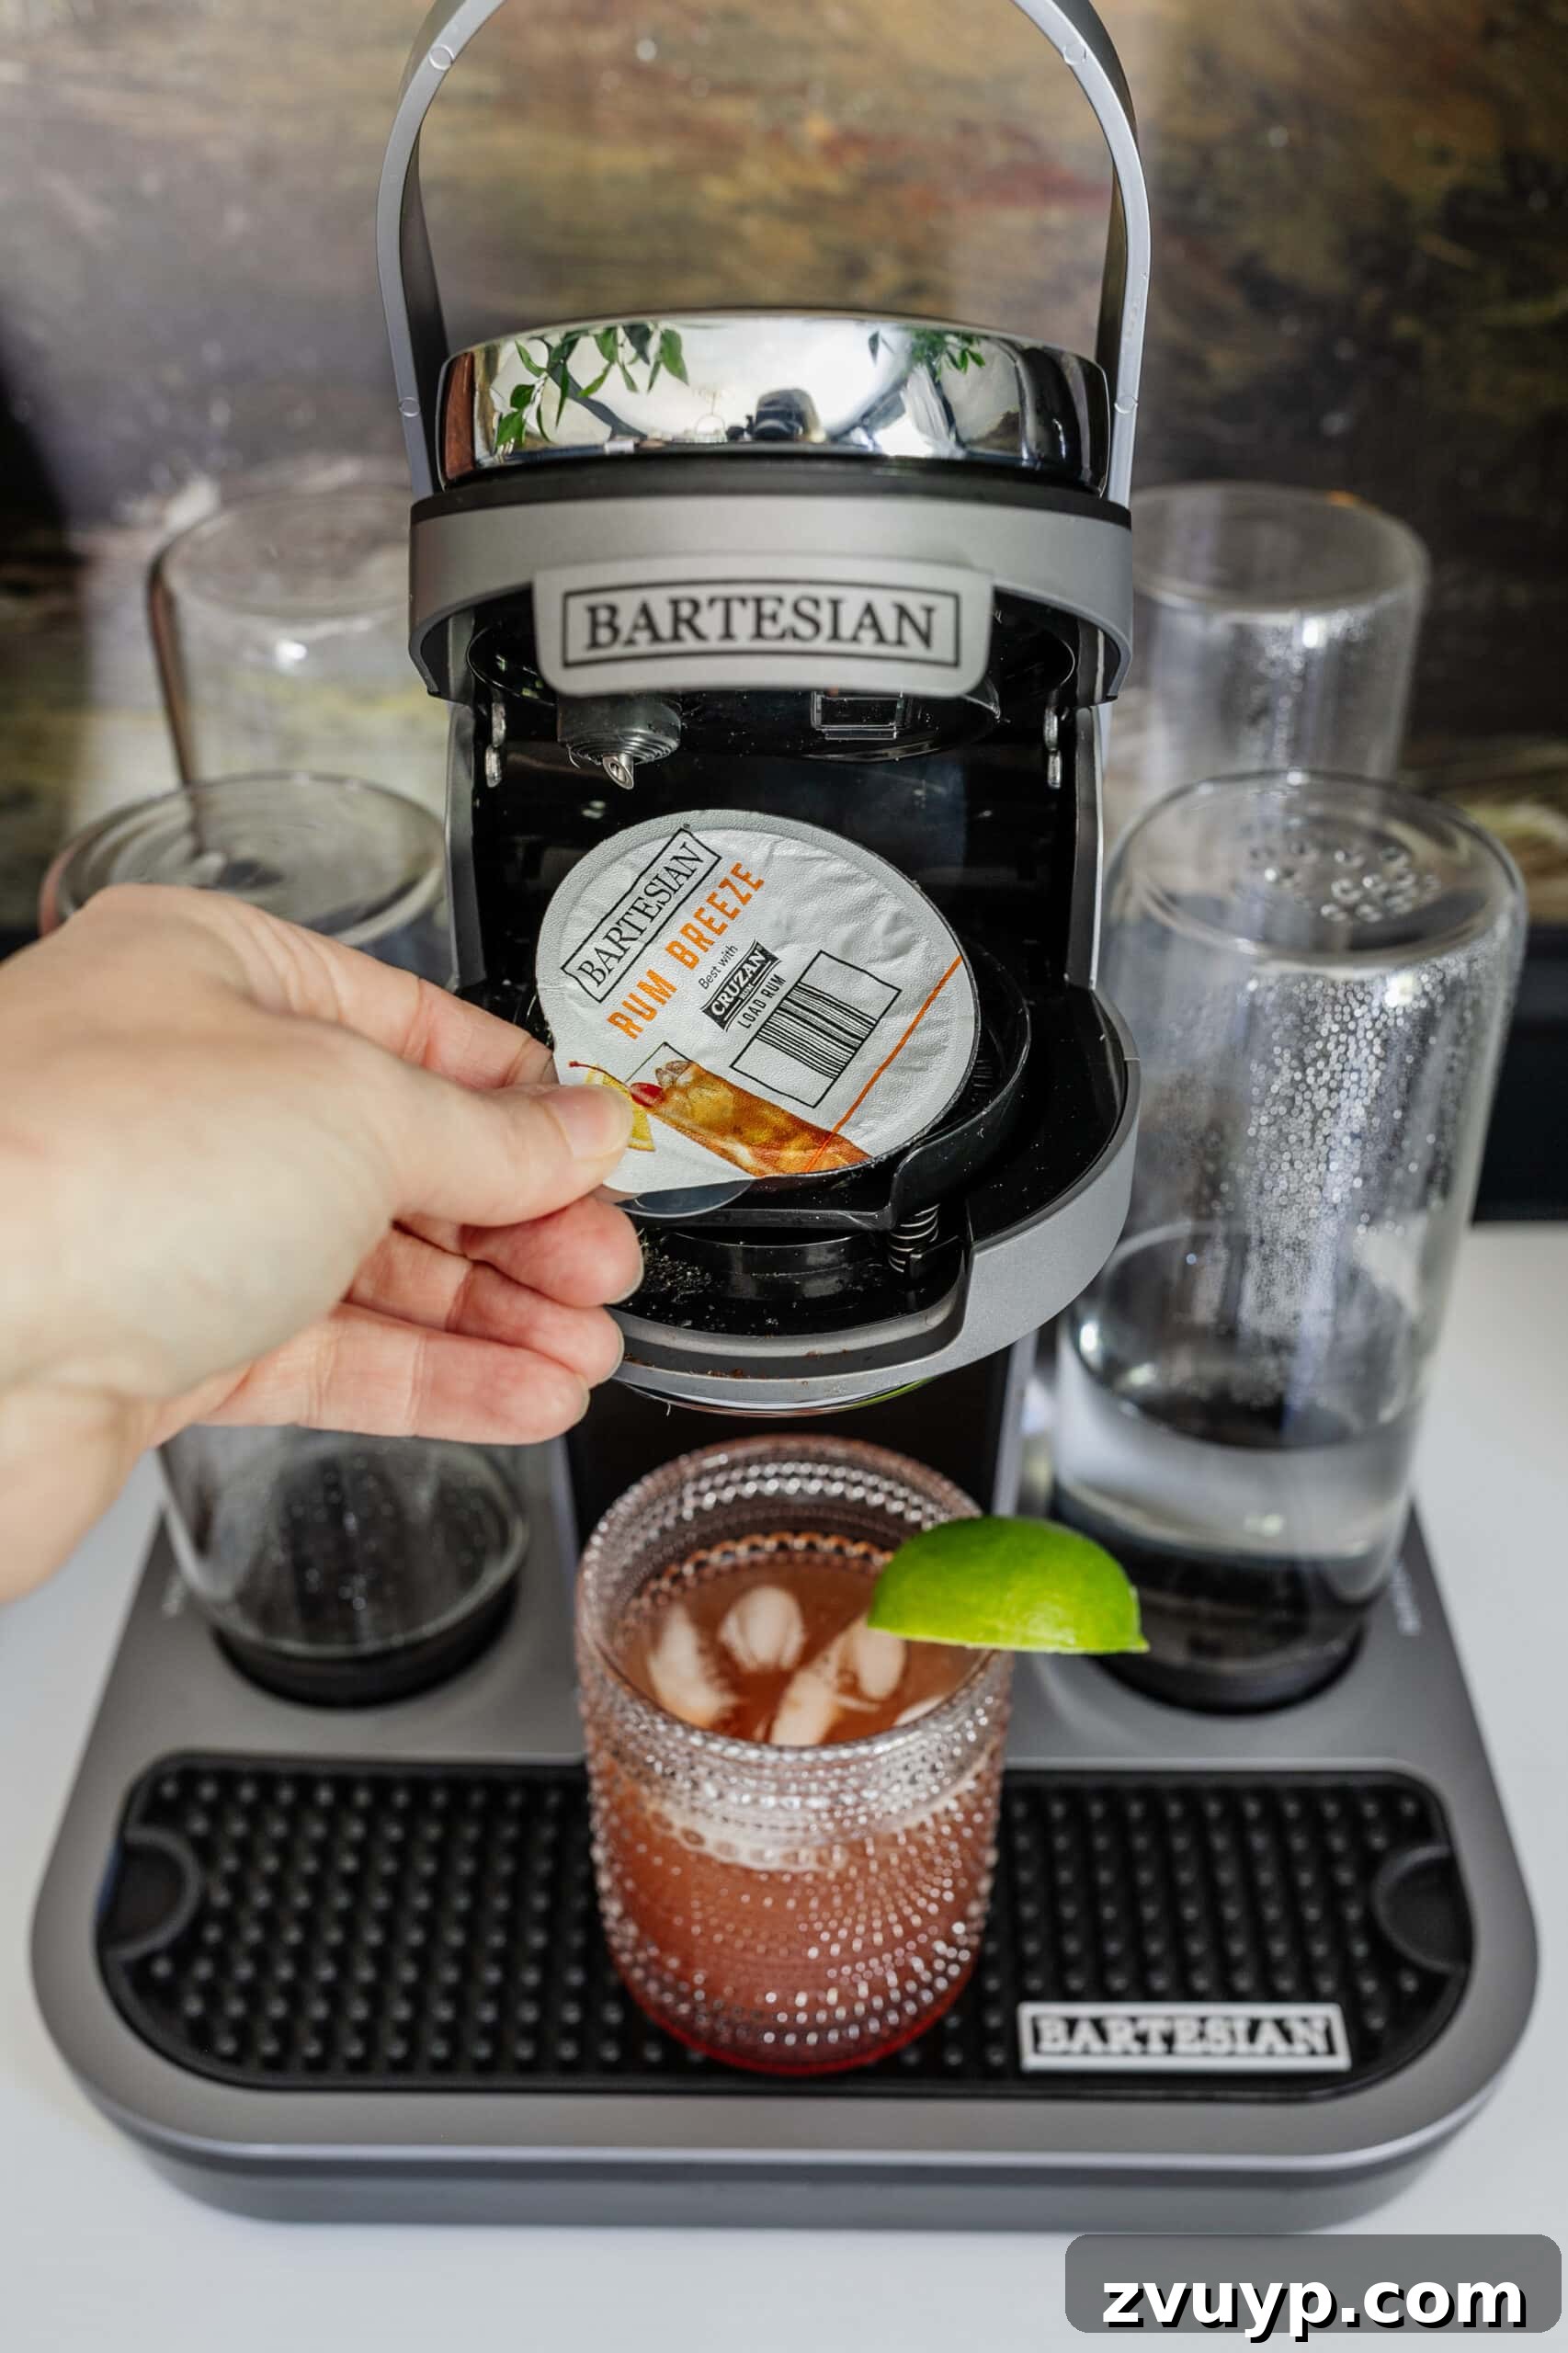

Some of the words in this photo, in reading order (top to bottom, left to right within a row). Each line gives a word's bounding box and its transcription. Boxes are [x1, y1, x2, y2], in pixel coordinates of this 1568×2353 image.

[585, 597, 936, 650] BARTESIAN
[577, 842, 704, 986] BARTESIAN
[607, 969, 676, 1040] RUM
[665, 862, 765, 970] BREEZE
[699, 966, 721, 989] Best
[718, 945, 738, 966] with
[711, 949, 766, 1016] CRUZAN
[737, 999, 767, 1029] LOAD
[761, 974, 786, 998] RUM
[1035, 2015, 1330, 2056] BARTESIAN
